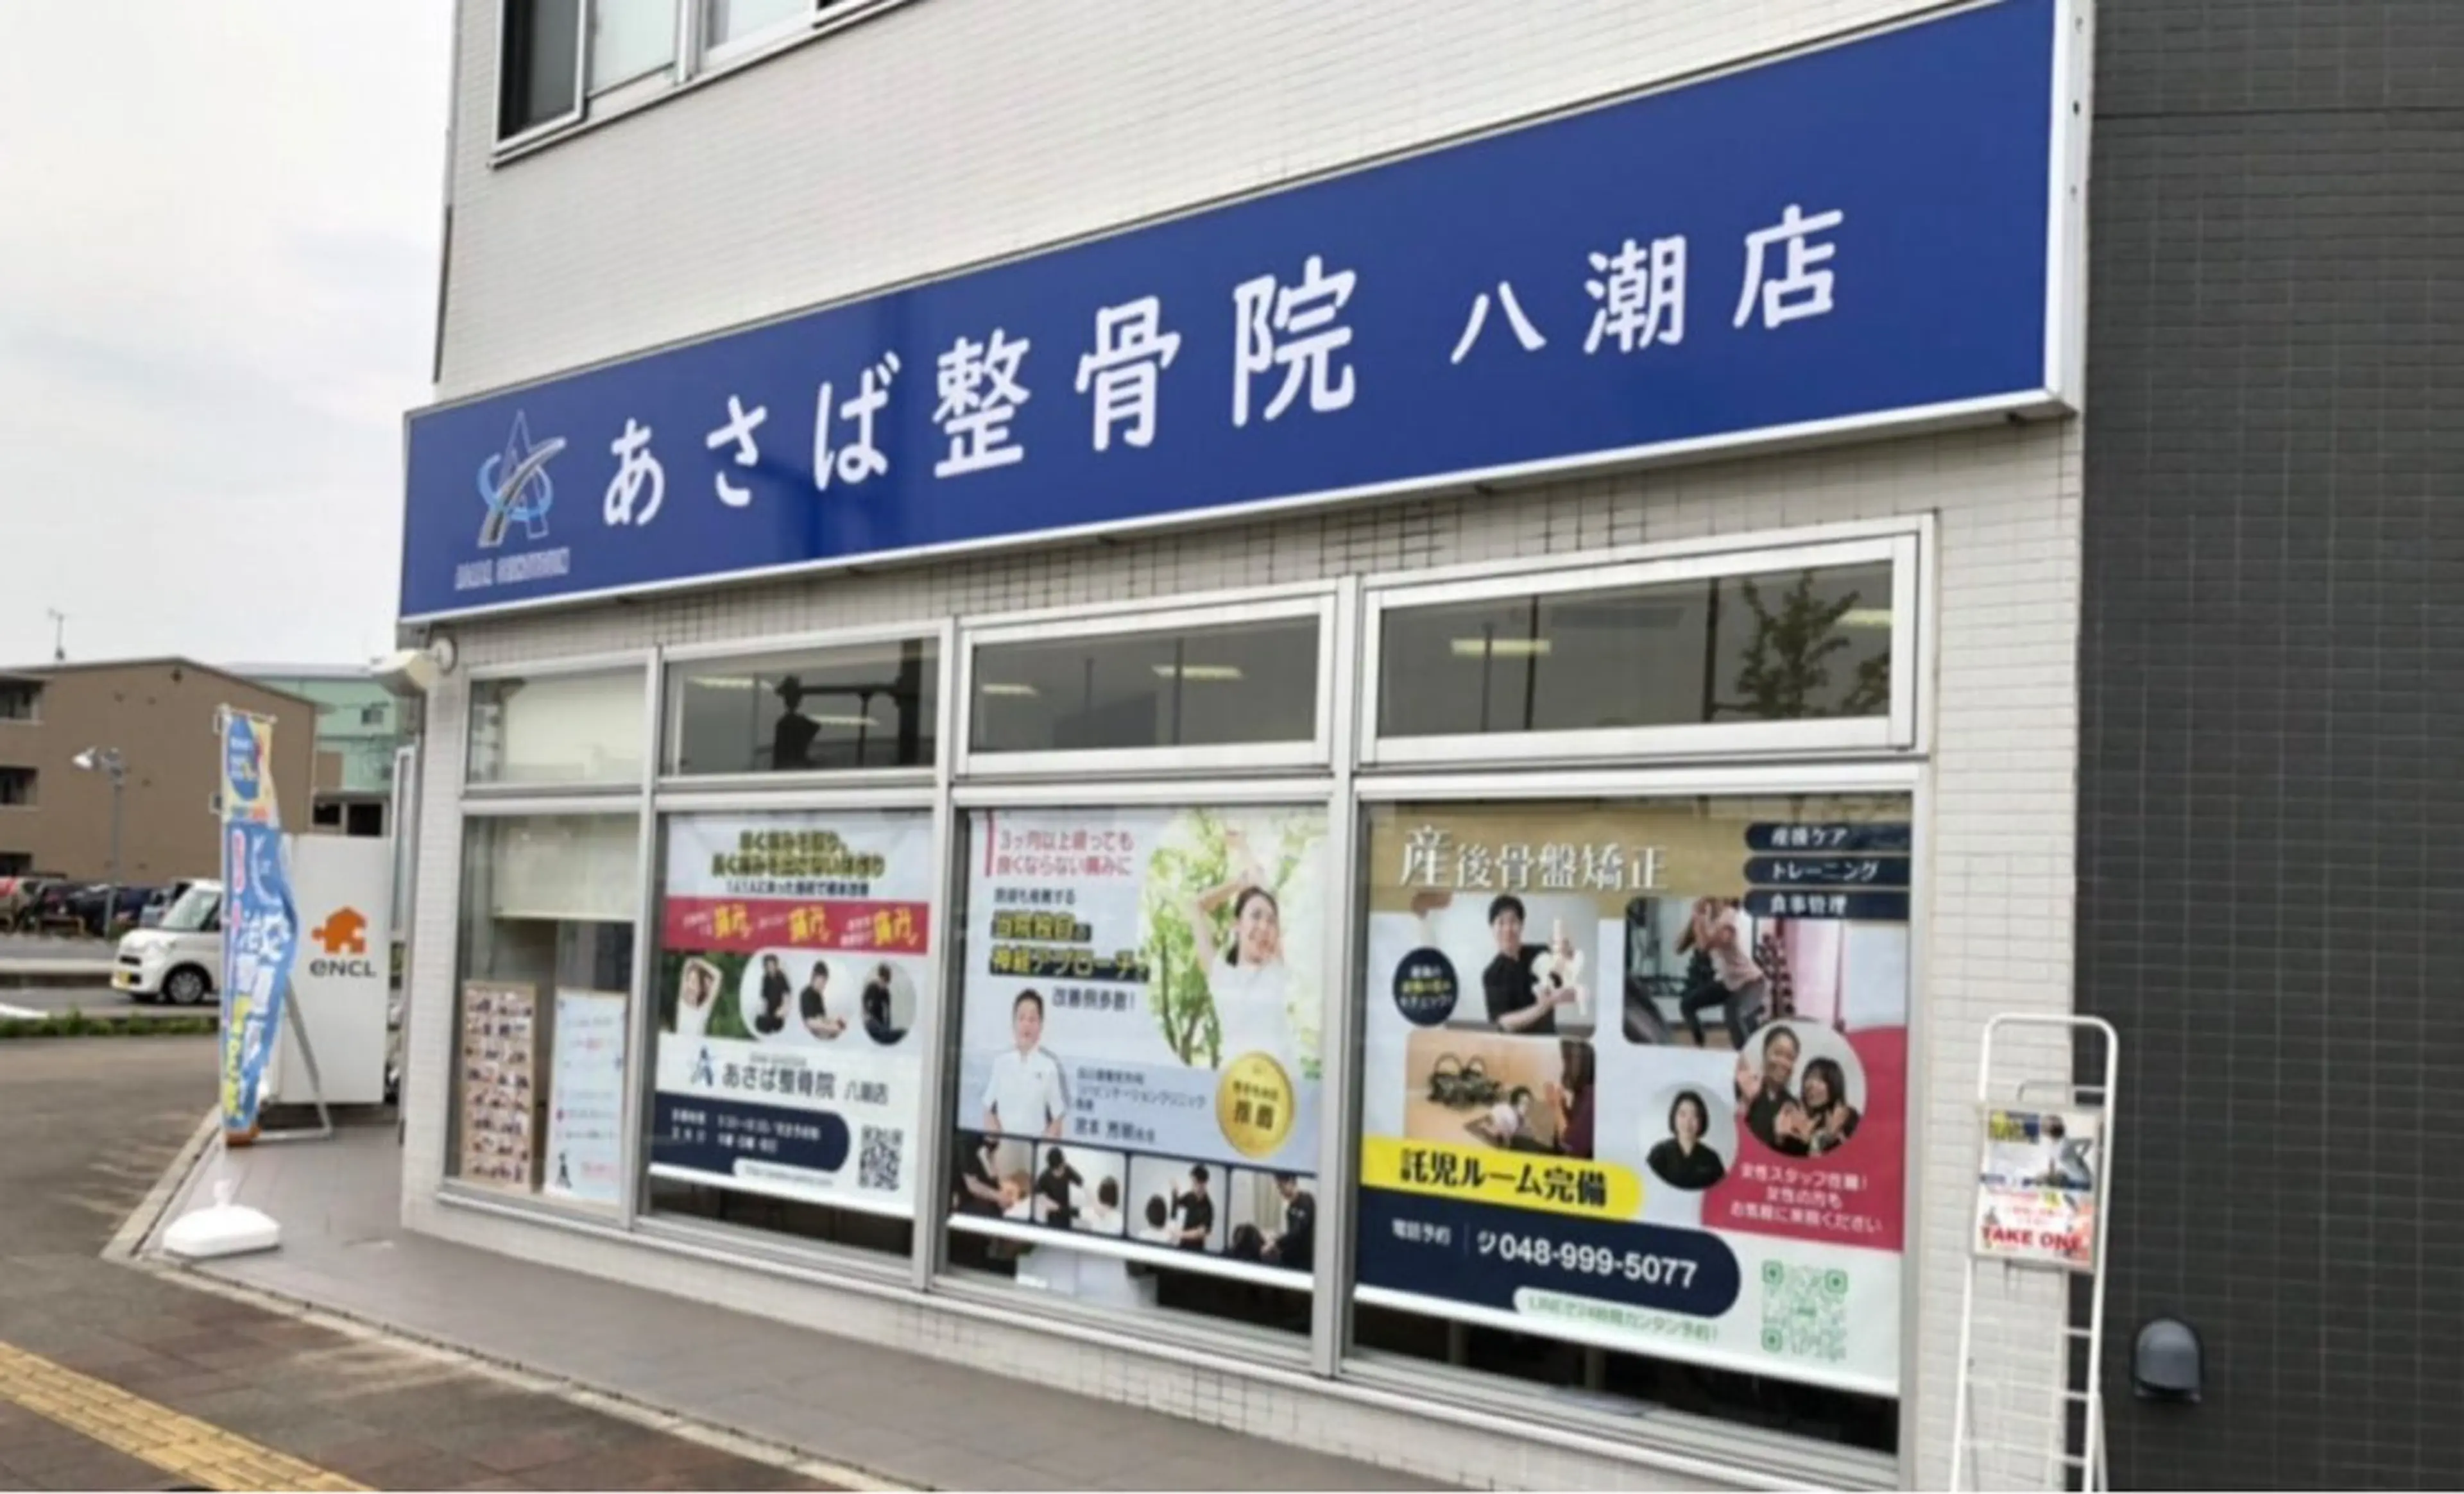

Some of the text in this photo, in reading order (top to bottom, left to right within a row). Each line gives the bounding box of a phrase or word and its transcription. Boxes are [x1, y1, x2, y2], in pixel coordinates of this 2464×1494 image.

[603, 203, 1844, 526] あさば整骨院 八潮店
[1399, 824, 1668, 891] 産後骨盤矯正
[1772, 860, 1880, 882] トレーニング
[1399, 1148, 1608, 1209] 託児ルーム完備
[1499, 1232, 1698, 1290] 048-999-5077
